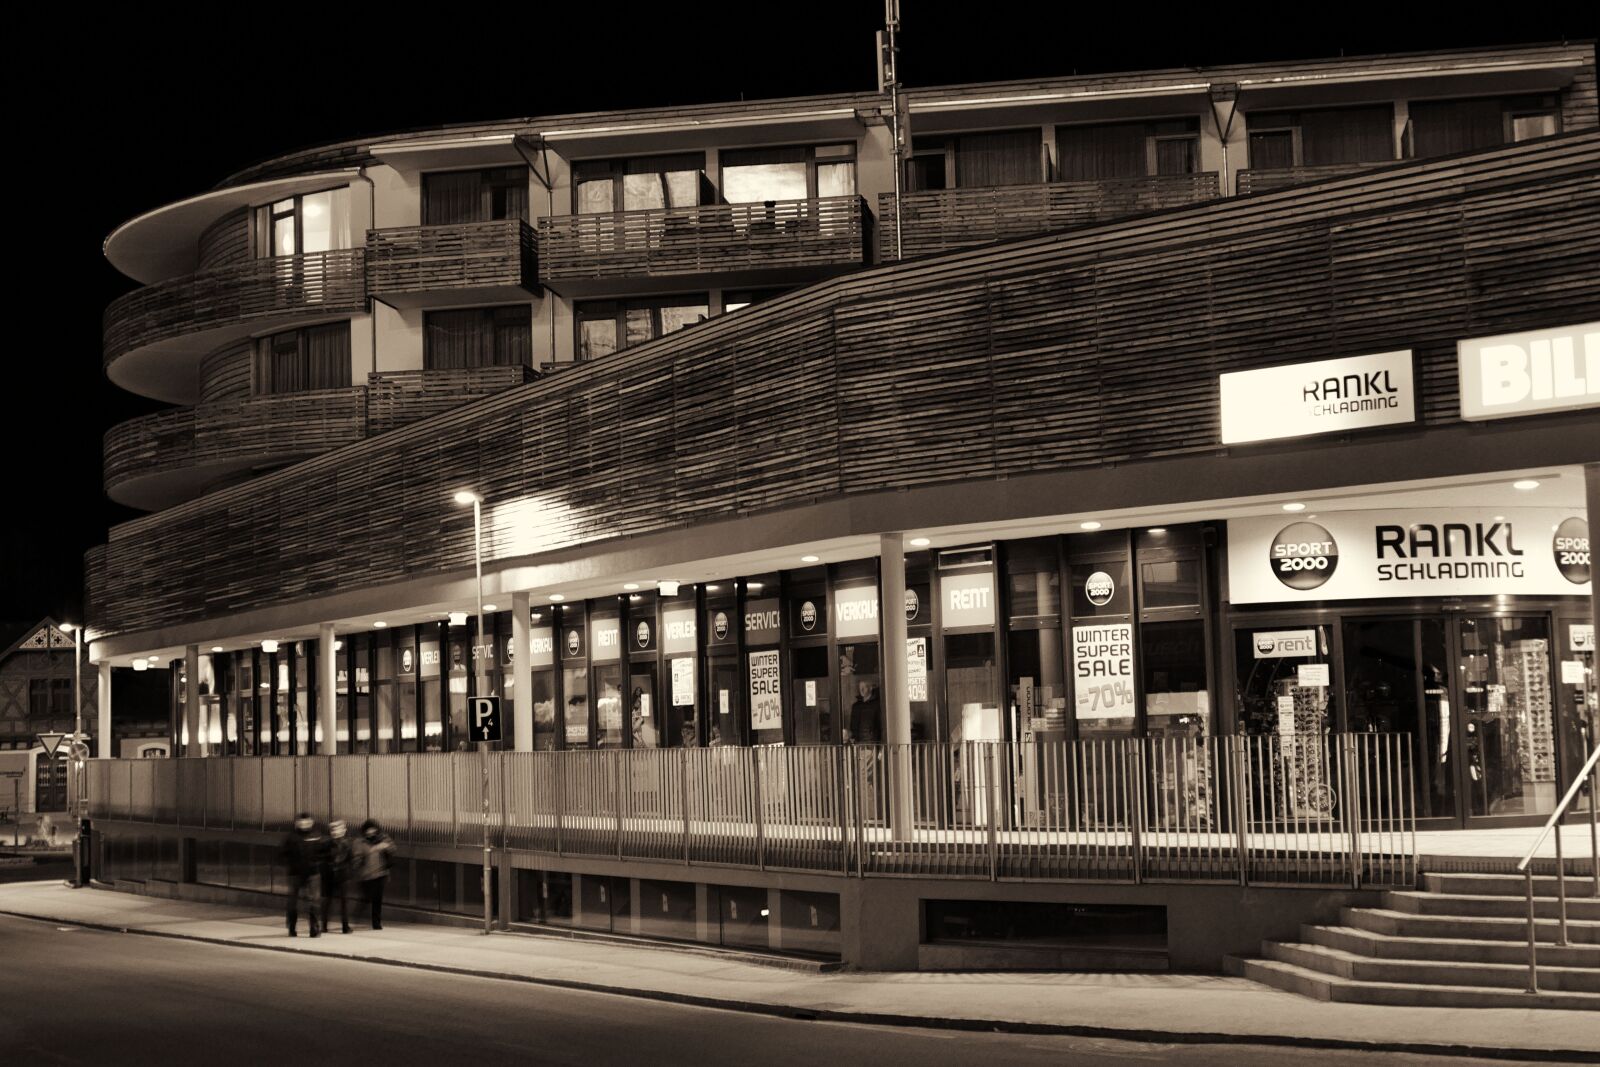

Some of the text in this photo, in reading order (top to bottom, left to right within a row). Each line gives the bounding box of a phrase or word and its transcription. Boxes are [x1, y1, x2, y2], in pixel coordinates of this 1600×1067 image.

[1303, 370, 1398, 402] RANKL
[1275, 541, 1332, 557] SPORT
[1376, 522, 1524, 559] RANKL
[1280, 556, 1328, 572] 2000
[1377, 561, 1524, 581] SCHLADMING
[1088, 581, 1112, 590] SPORT
[1090, 588, 1109, 596] 2000
[950, 587, 990, 611] RENT
[1077, 628, 1130, 643] WINTER
[1277, 635, 1312, 652] rent
[1077, 643, 1130, 658] SUPER
[751, 654, 778, 667] WINTER
[1078, 659, 1131, 678] SALE
[751, 667, 778, 680] SUPER
[752, 679, 779, 696] SALE
[1078, 680, 1133, 712] -70%
[476, 699, 493, 727] P
[753, 697, 780, 723] -70%
